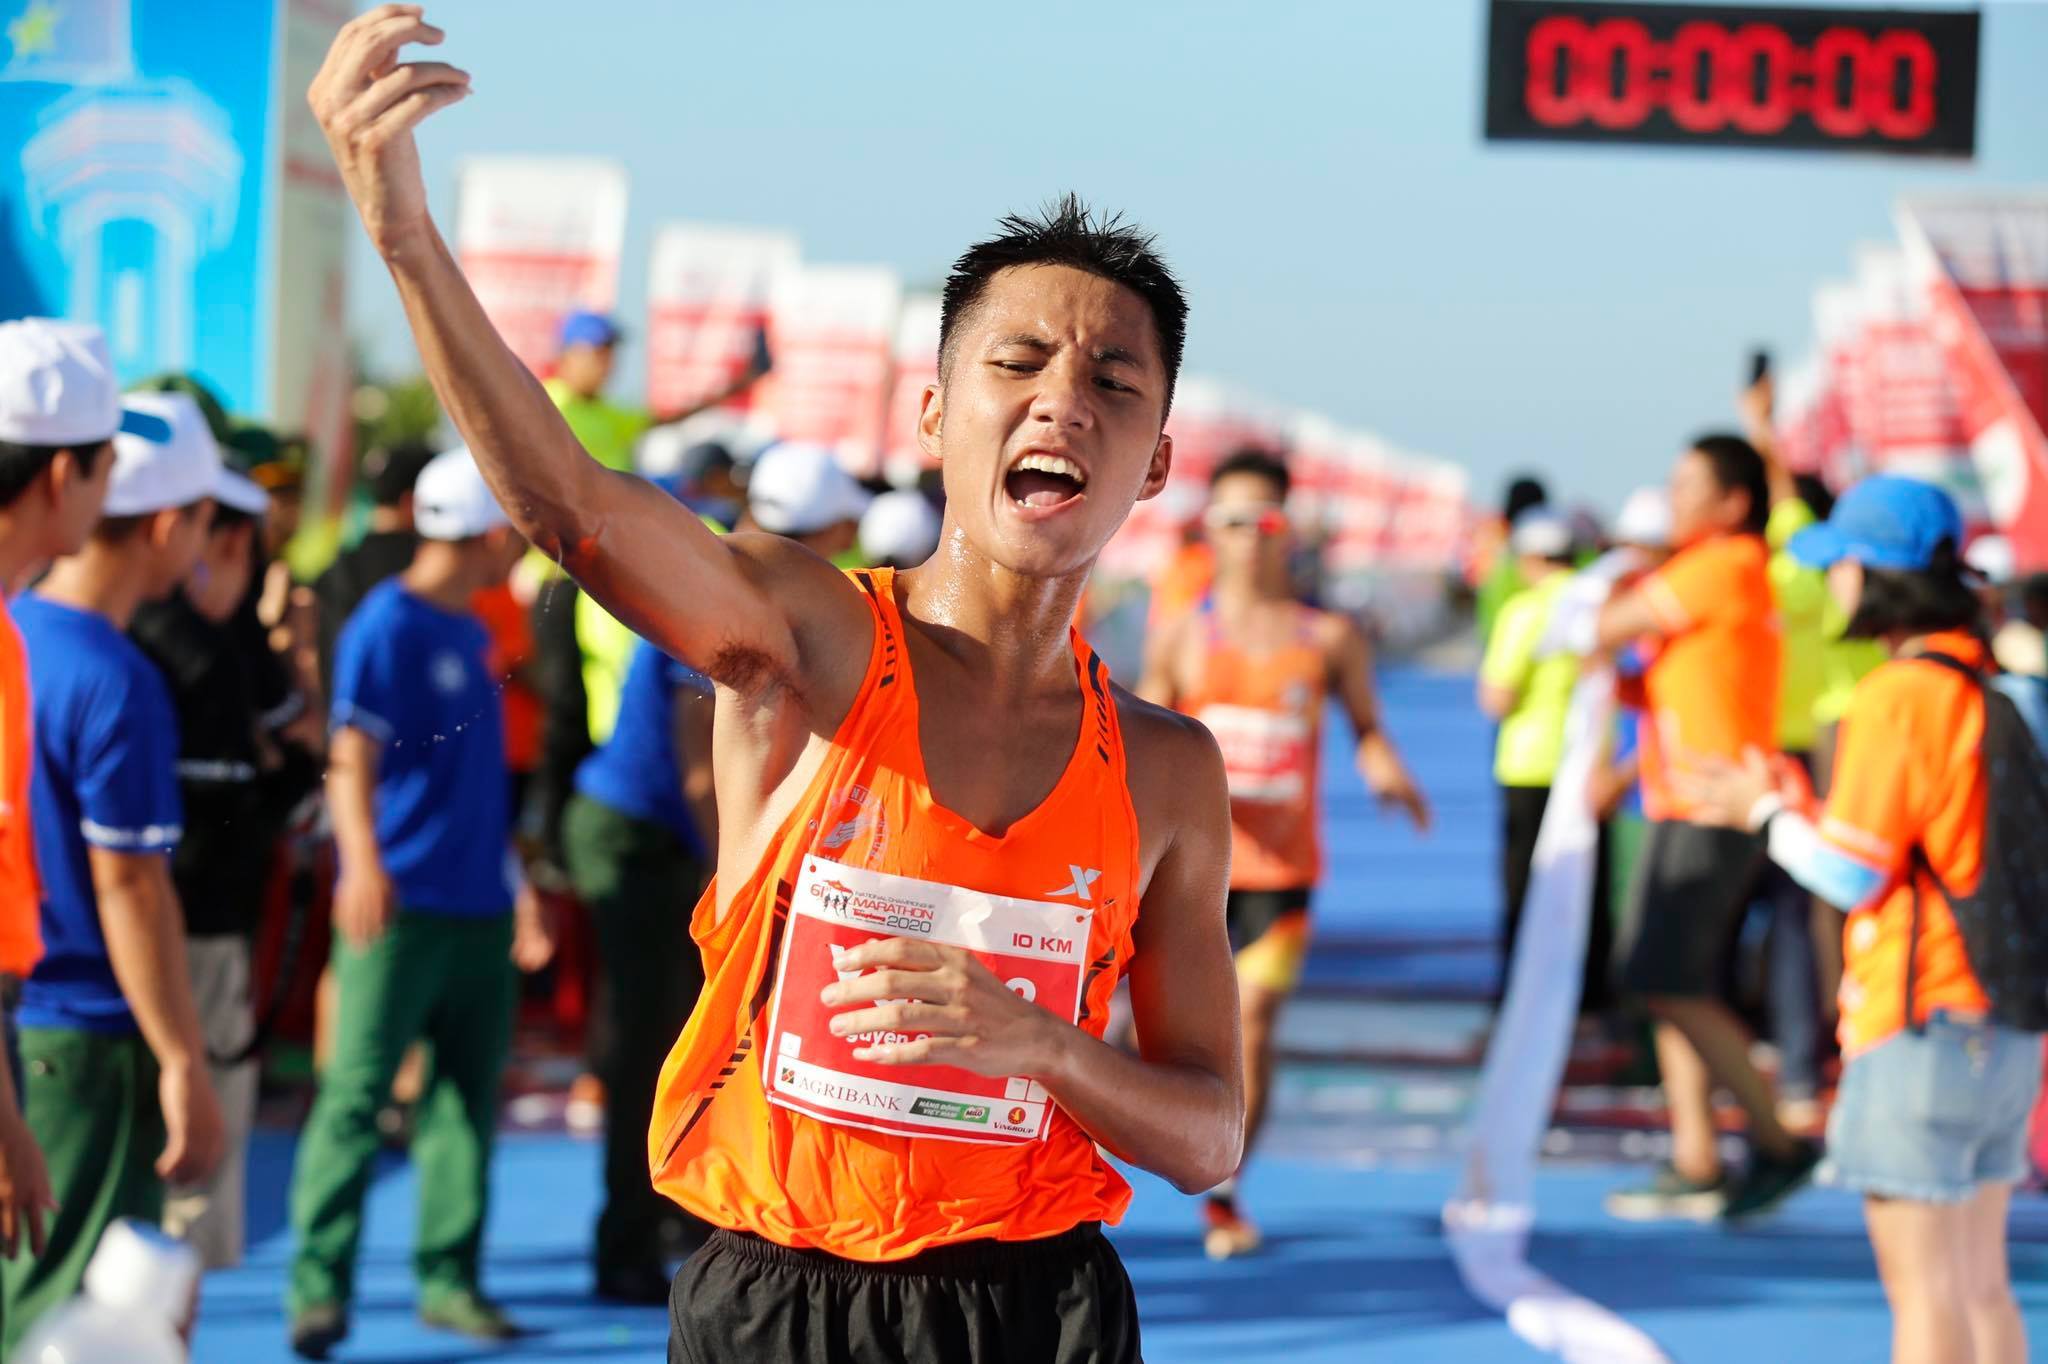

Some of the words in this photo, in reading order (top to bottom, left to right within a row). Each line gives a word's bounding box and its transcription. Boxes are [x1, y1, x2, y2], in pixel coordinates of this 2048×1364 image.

[1526, 15, 1937, 141] 00:00:00
[853, 897, 934, 920] MARATHON
[886, 915, 932, 933] 2020
[1040, 937, 1073, 954] KM
[798, 1075, 903, 1111] AGRIBANK
